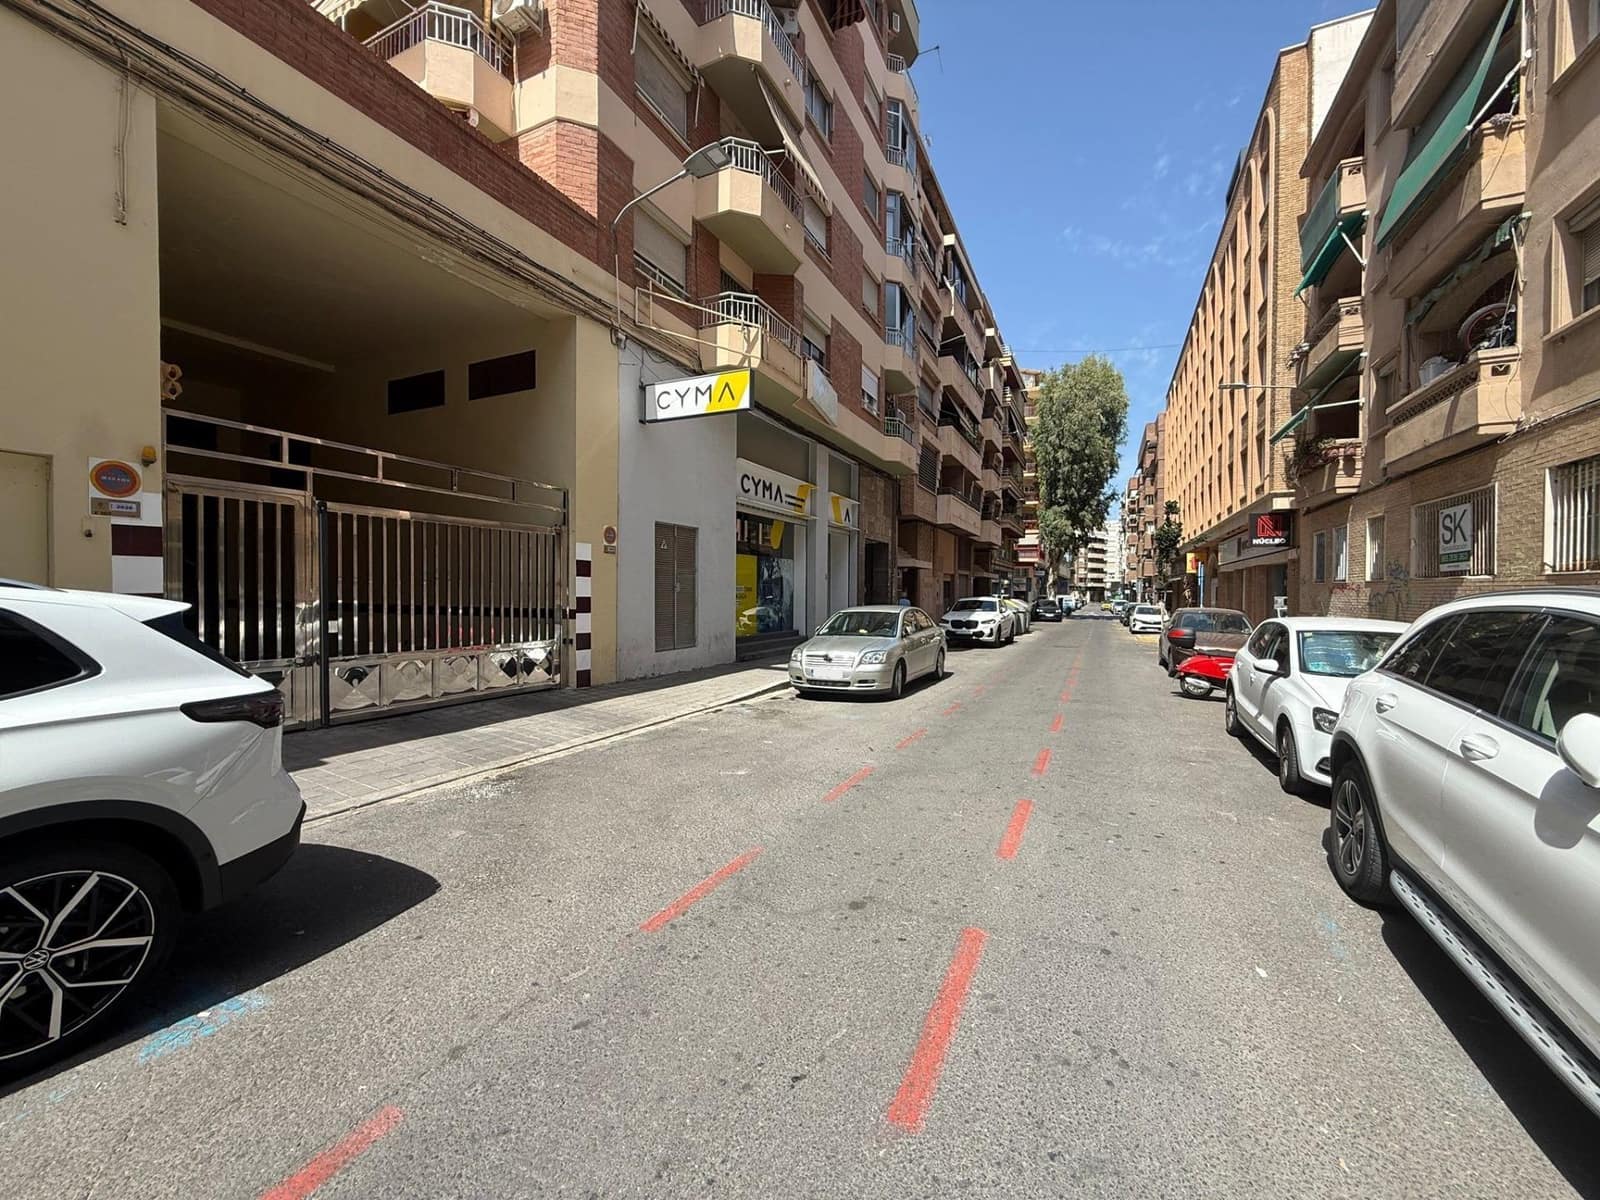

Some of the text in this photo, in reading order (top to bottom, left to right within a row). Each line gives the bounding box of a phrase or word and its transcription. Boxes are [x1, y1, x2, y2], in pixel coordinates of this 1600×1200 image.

[656, 382, 735, 410] CYMA
[740, 473, 783, 504] CYMA
[1441, 509, 1468, 544] SK
